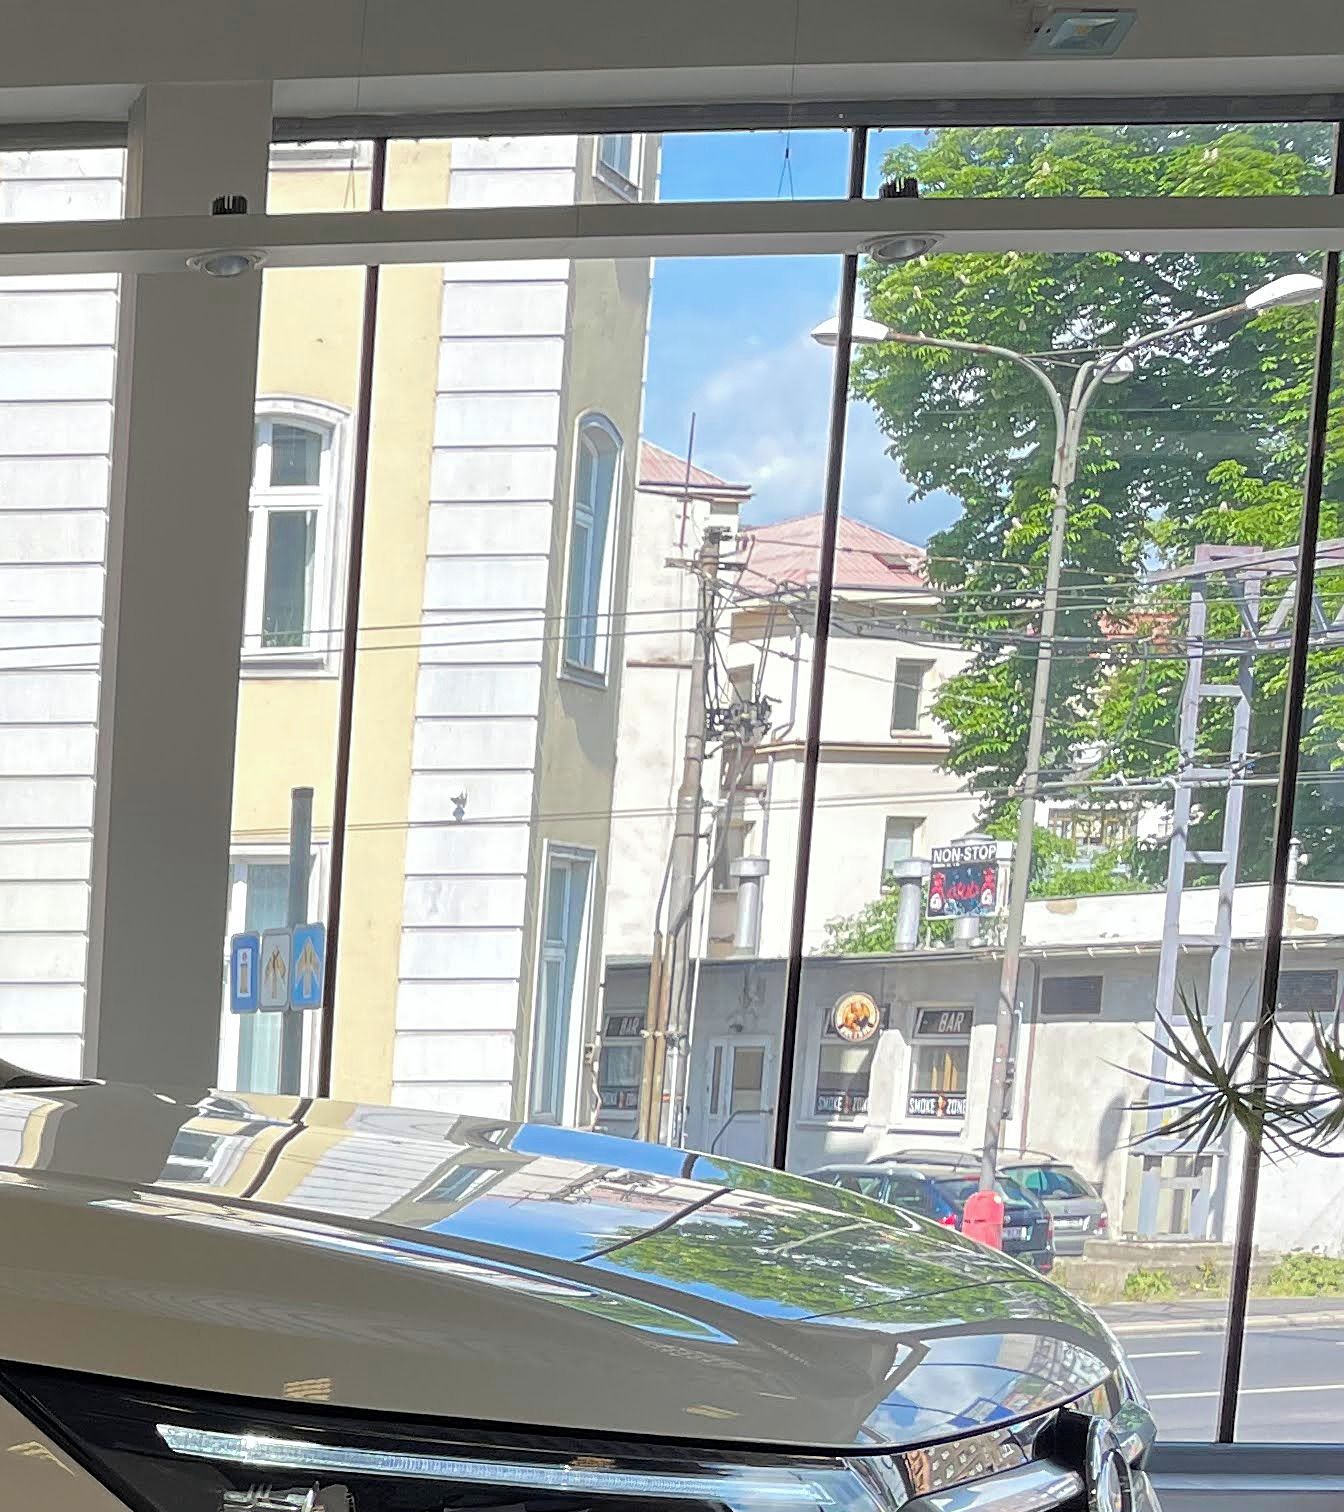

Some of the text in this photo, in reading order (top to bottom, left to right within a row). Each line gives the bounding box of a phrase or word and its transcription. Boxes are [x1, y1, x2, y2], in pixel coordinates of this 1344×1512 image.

[933, 845, 996, 863] NON-STOP
[938, 1012, 964, 1033] BAR
[909, 1098, 936, 1115] SMOKE
